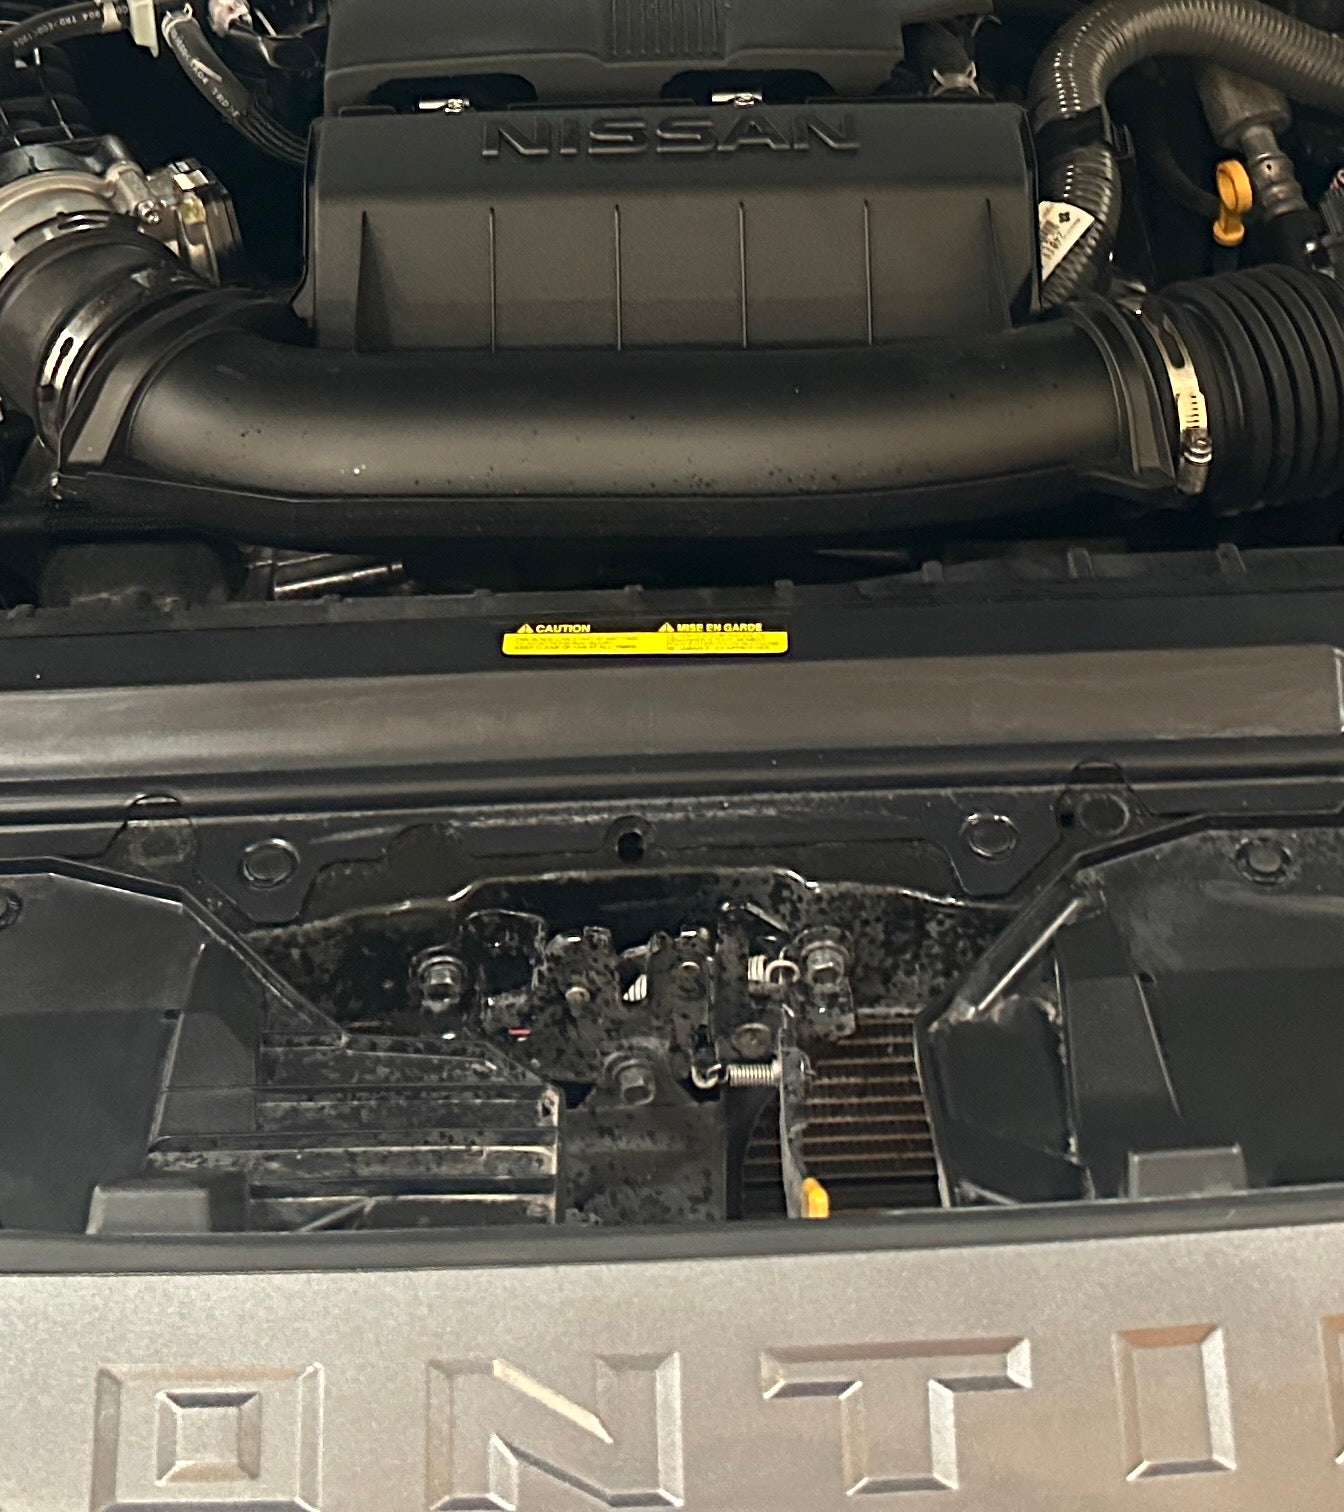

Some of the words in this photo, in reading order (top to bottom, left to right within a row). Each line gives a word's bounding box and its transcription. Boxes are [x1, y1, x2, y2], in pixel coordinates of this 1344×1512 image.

[480, 113, 862, 157] NISSAN
[535, 624, 591, 633] CAUTION
[676, 623, 704, 632] MISE
[705, 623, 722, 632] EN
[723, 622, 763, 632] GARDE
